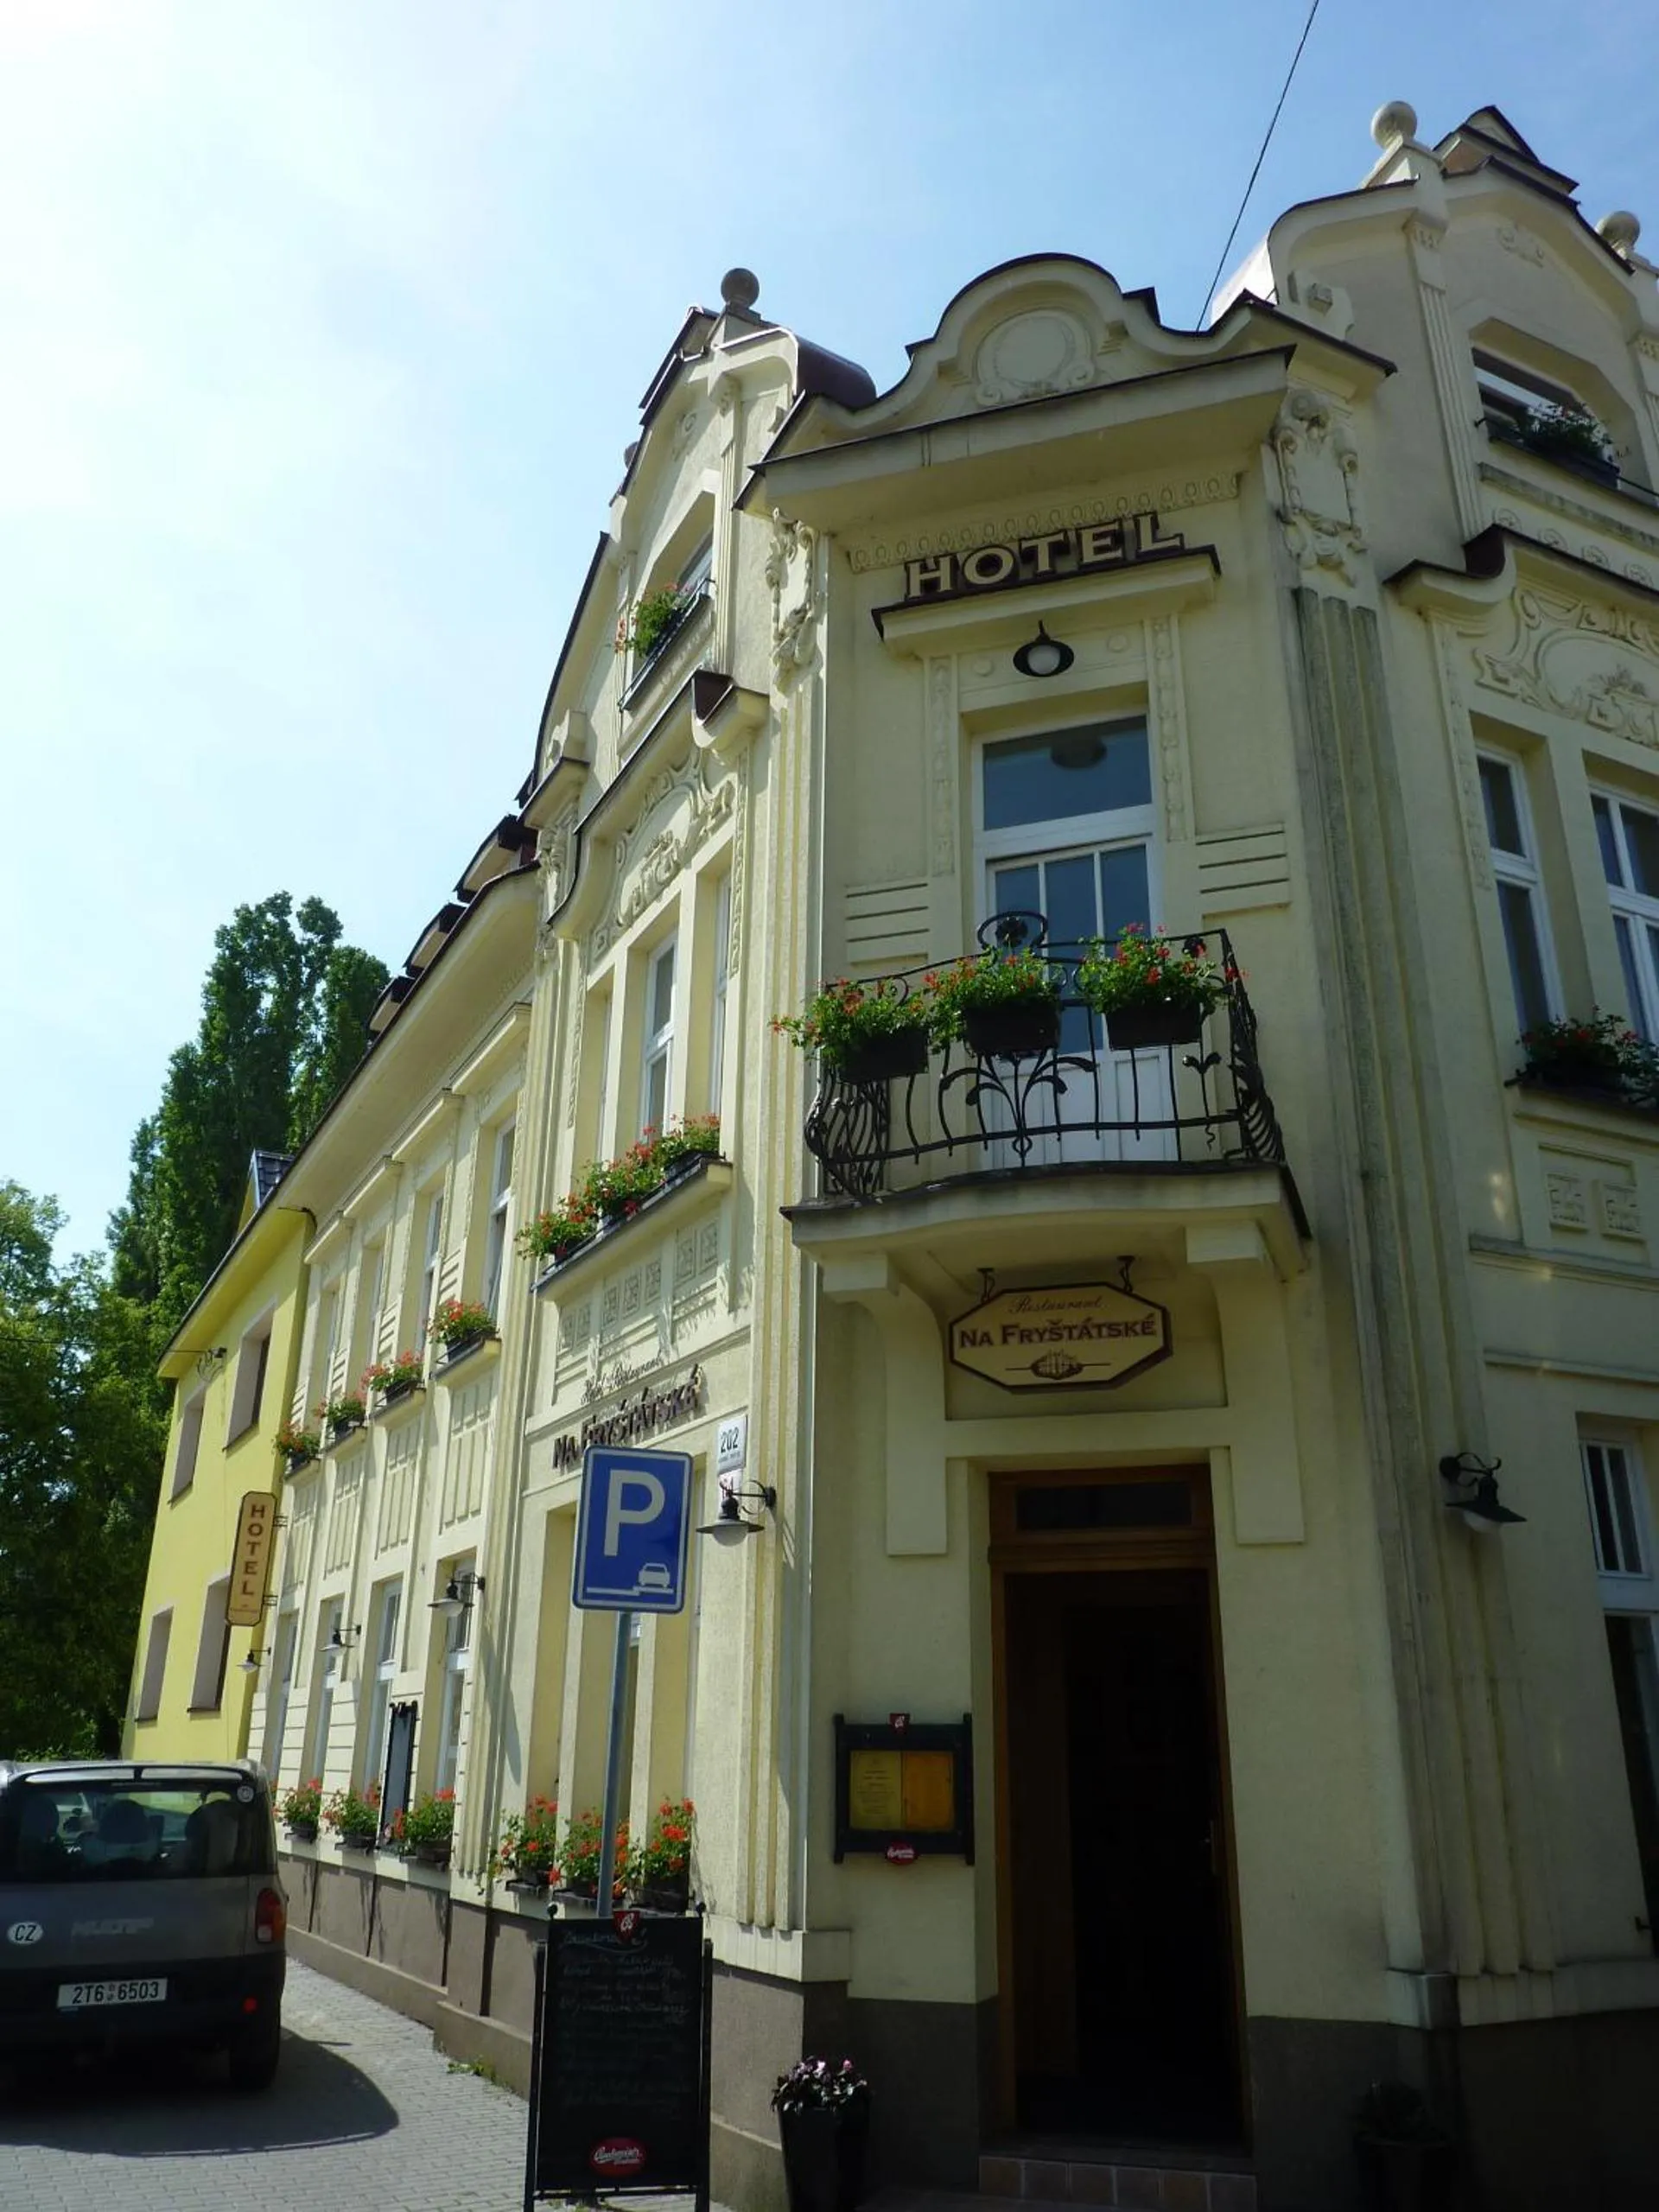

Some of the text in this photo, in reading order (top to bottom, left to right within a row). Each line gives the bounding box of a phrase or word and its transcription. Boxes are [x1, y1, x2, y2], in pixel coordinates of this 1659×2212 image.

[905, 511, 1185, 600] HOTEL
[1008, 1295, 1103, 1313] Restaurant
[720, 1427, 740, 1453] 202
[604, 1469, 665, 1556] P
[241, 1504, 265, 1596] HOTEL
[14, 1924, 37, 1942] CZ
[73, 1980, 159, 2005] 2T6 6503
